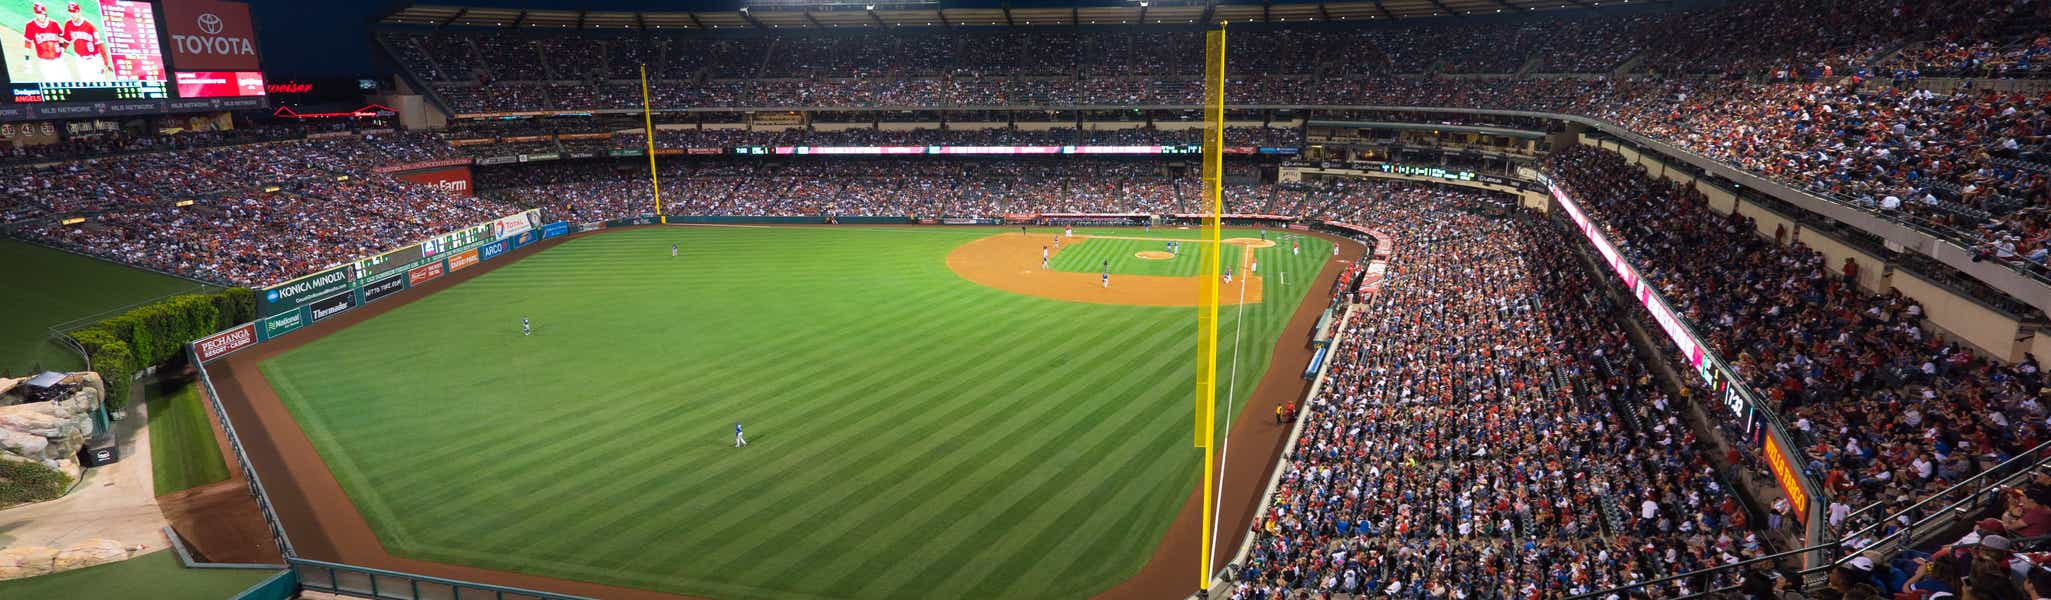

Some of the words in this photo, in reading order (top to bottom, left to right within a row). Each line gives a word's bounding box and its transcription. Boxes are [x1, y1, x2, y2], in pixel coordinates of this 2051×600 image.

[172, 34, 255, 55] TOYOTA
[268, 81, 312, 92] weiser
[440, 179, 466, 191] Farm
[485, 243, 503, 257] ARCO
[279, 282, 312, 299] KONICA
[313, 272, 345, 289] MINOLTA
[366, 287, 380, 296] NITTO
[313, 302, 348, 319] Thermador
[275, 314, 300, 327] National
[202, 329, 250, 351] PECHANGA
[205, 345, 227, 358] RESORT
[231, 338, 250, 348] CASINO
[1767, 435, 1784, 476] WELLS
[1783, 466, 1805, 512] FARGO
